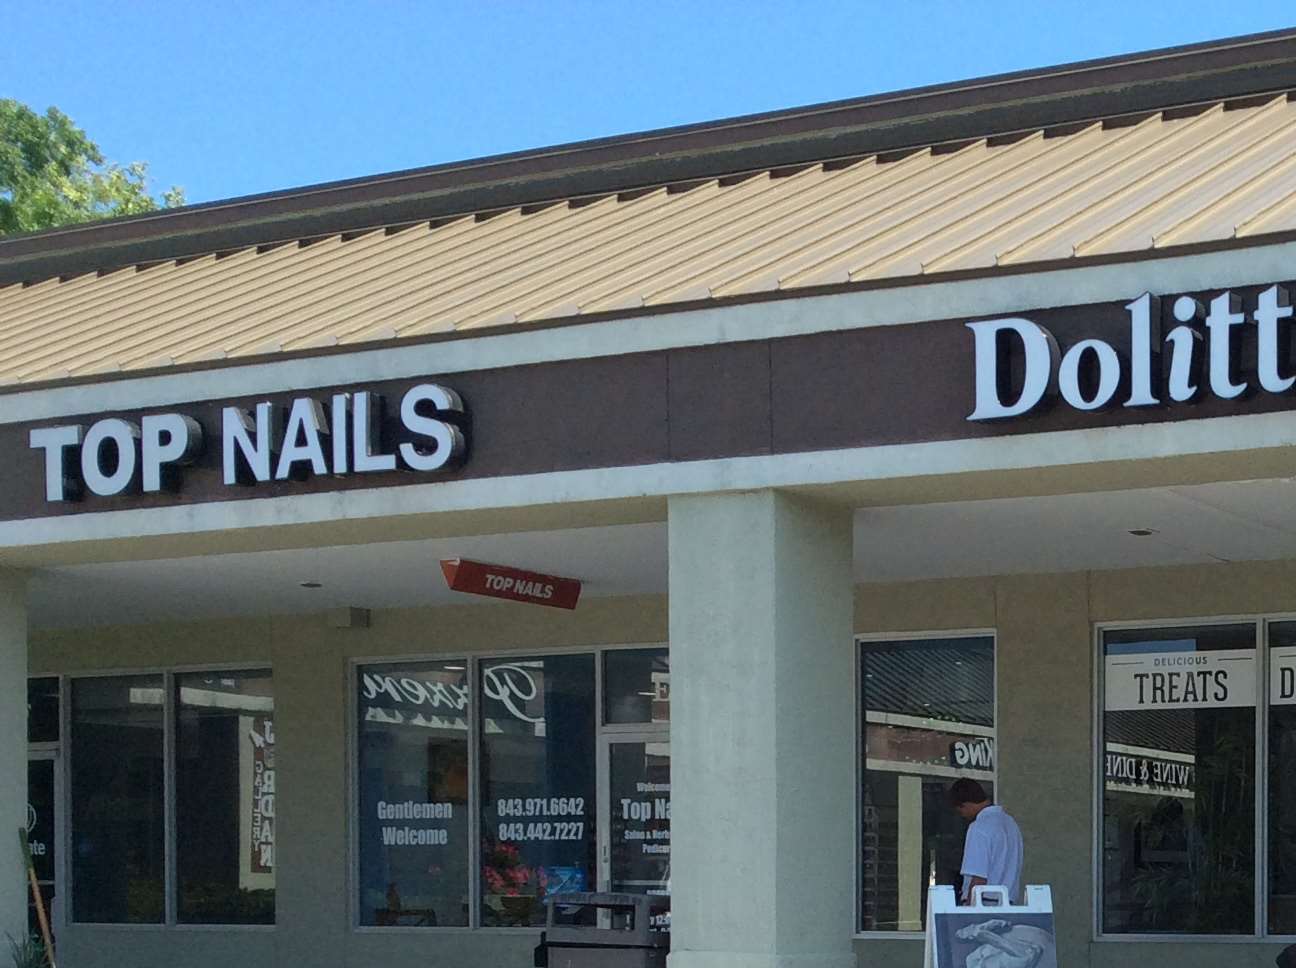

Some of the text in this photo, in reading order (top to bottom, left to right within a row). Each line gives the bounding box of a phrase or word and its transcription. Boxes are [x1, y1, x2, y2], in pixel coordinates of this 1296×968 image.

[29, 383, 460, 502] TOP NAILS
[484, 573, 555, 599] TOP NAILS
[1153, 655, 1209, 667] DELICIOUS
[1133, 669, 1229, 705] TREATS
[376, 800, 453, 820] Gentlemen
[497, 797, 585, 817] 843.971.6642
[620, 798, 651, 822] Top
[381, 826, 448, 846] Welcome
[498, 821, 584, 841] 843.442.7227
